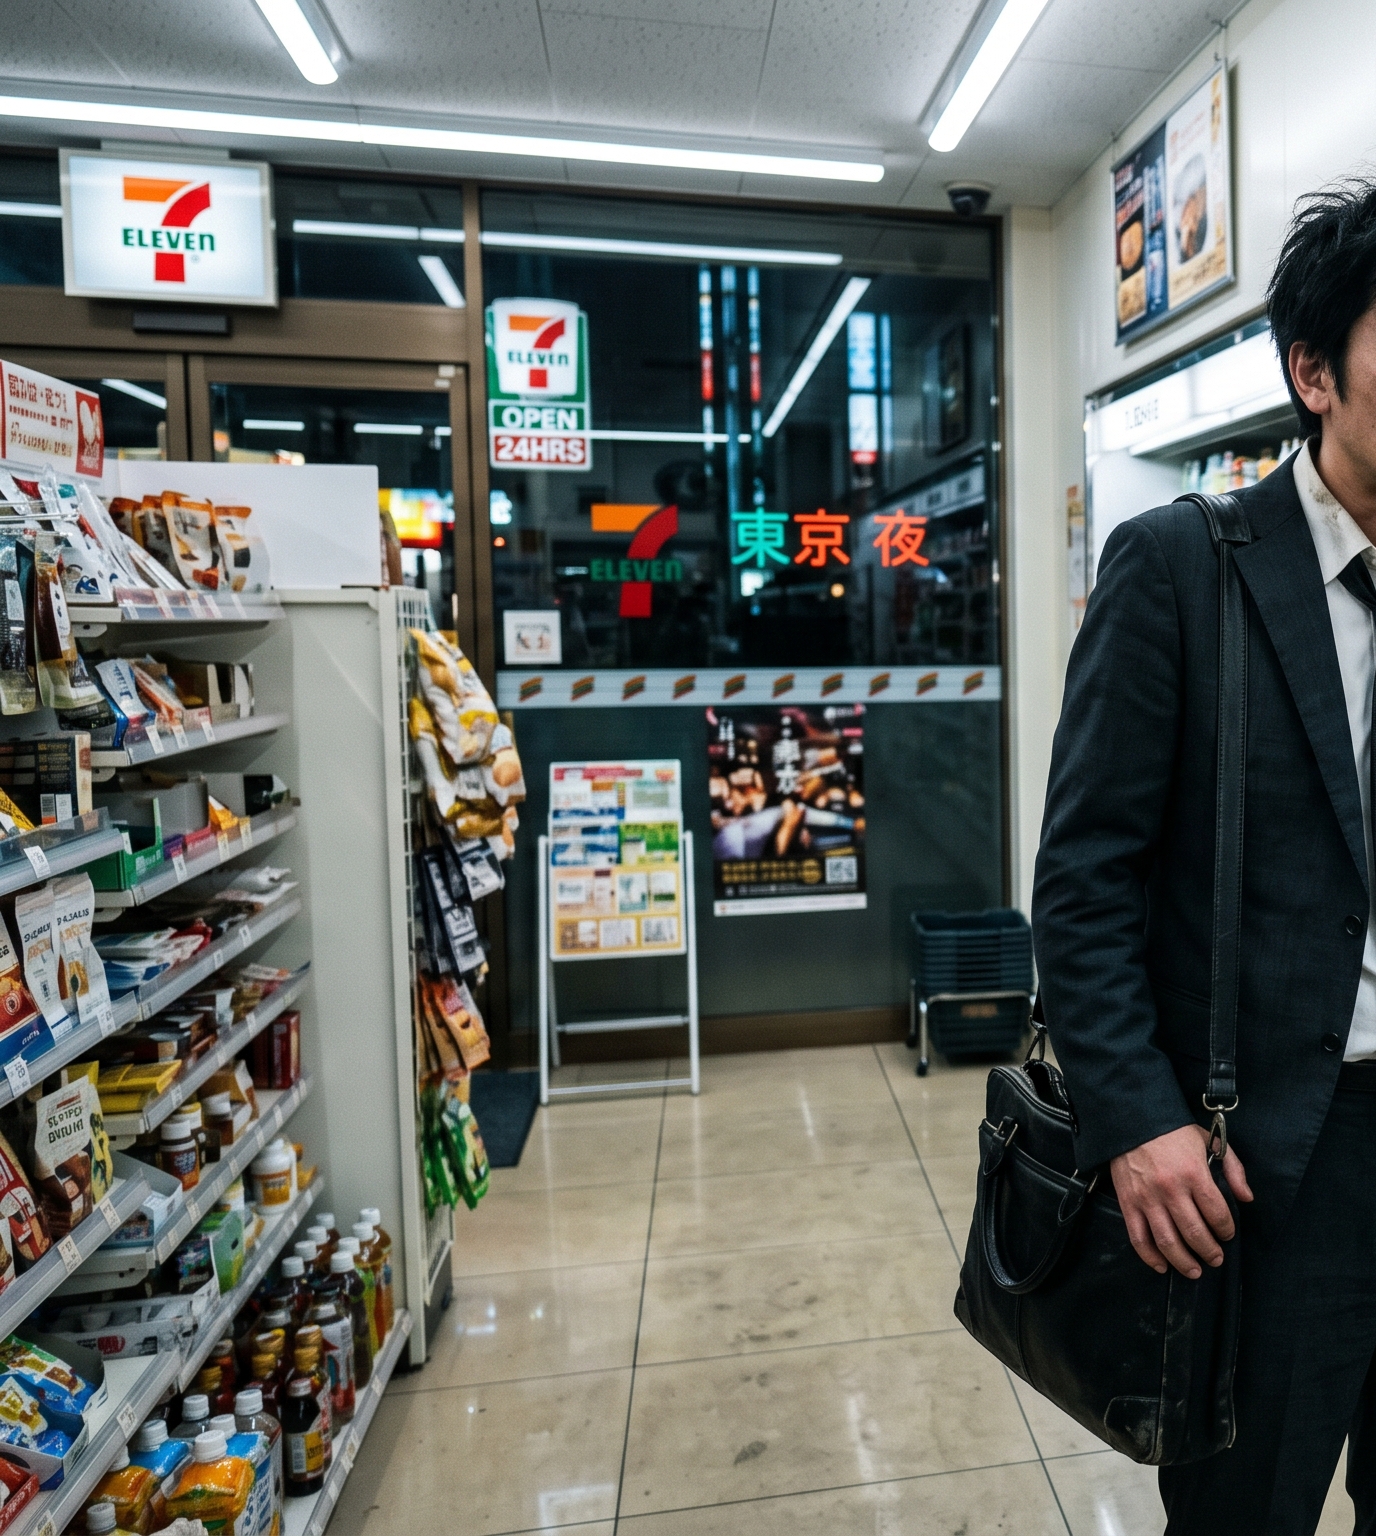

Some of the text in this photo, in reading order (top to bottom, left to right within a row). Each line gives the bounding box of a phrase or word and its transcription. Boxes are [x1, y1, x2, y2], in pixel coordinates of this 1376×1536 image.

[502, 406, 578, 431] OPEN
[497, 437, 585, 464] 24HRS
[731, 507, 930, 568] 東京 夜
